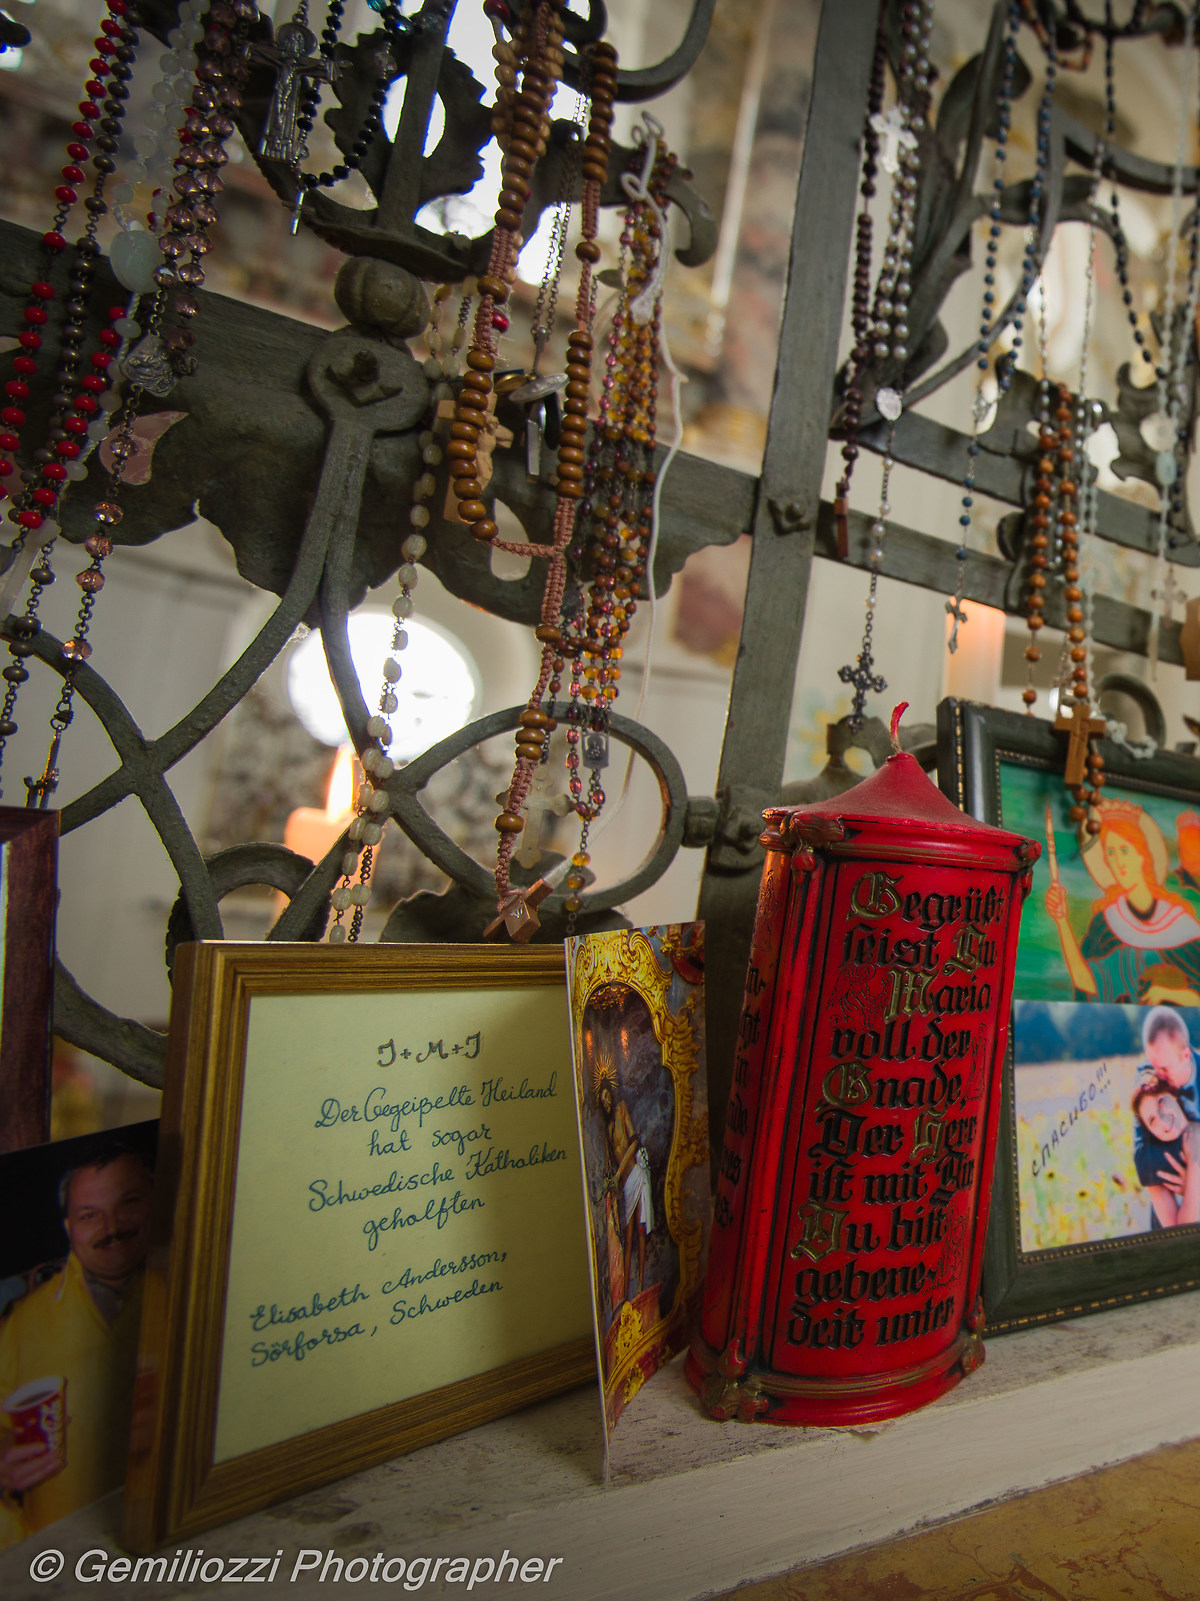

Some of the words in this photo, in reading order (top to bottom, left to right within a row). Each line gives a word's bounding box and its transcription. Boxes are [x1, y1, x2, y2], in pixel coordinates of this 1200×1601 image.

[942, 924, 999, 976] Du
[884, 968, 991, 1022] Maria
[829, 1019, 916, 1063] voll
[919, 1017, 971, 1062] der
[315, 1098, 363, 1128] Der
[480, 1072, 558, 1107] Heiland
[367, 1129, 412, 1157] hat
[431, 1123, 493, 1157] sogar
[808, 1111, 904, 1158] Der
[910, 1108, 977, 1162] Herr
[308, 1162, 456, 1213] Schwedische
[464, 1142, 568, 1181] Katholiken
[862, 1161, 930, 1205] mit
[362, 1196, 486, 1252] geholften
[790, 1202, 880, 1260] Du
[250, 1284, 370, 1332] Elisabeth
[389, 1279, 504, 1326] Schweden
[787, 1300, 866, 1351] deit
[873, 1296, 956, 1347] unter
